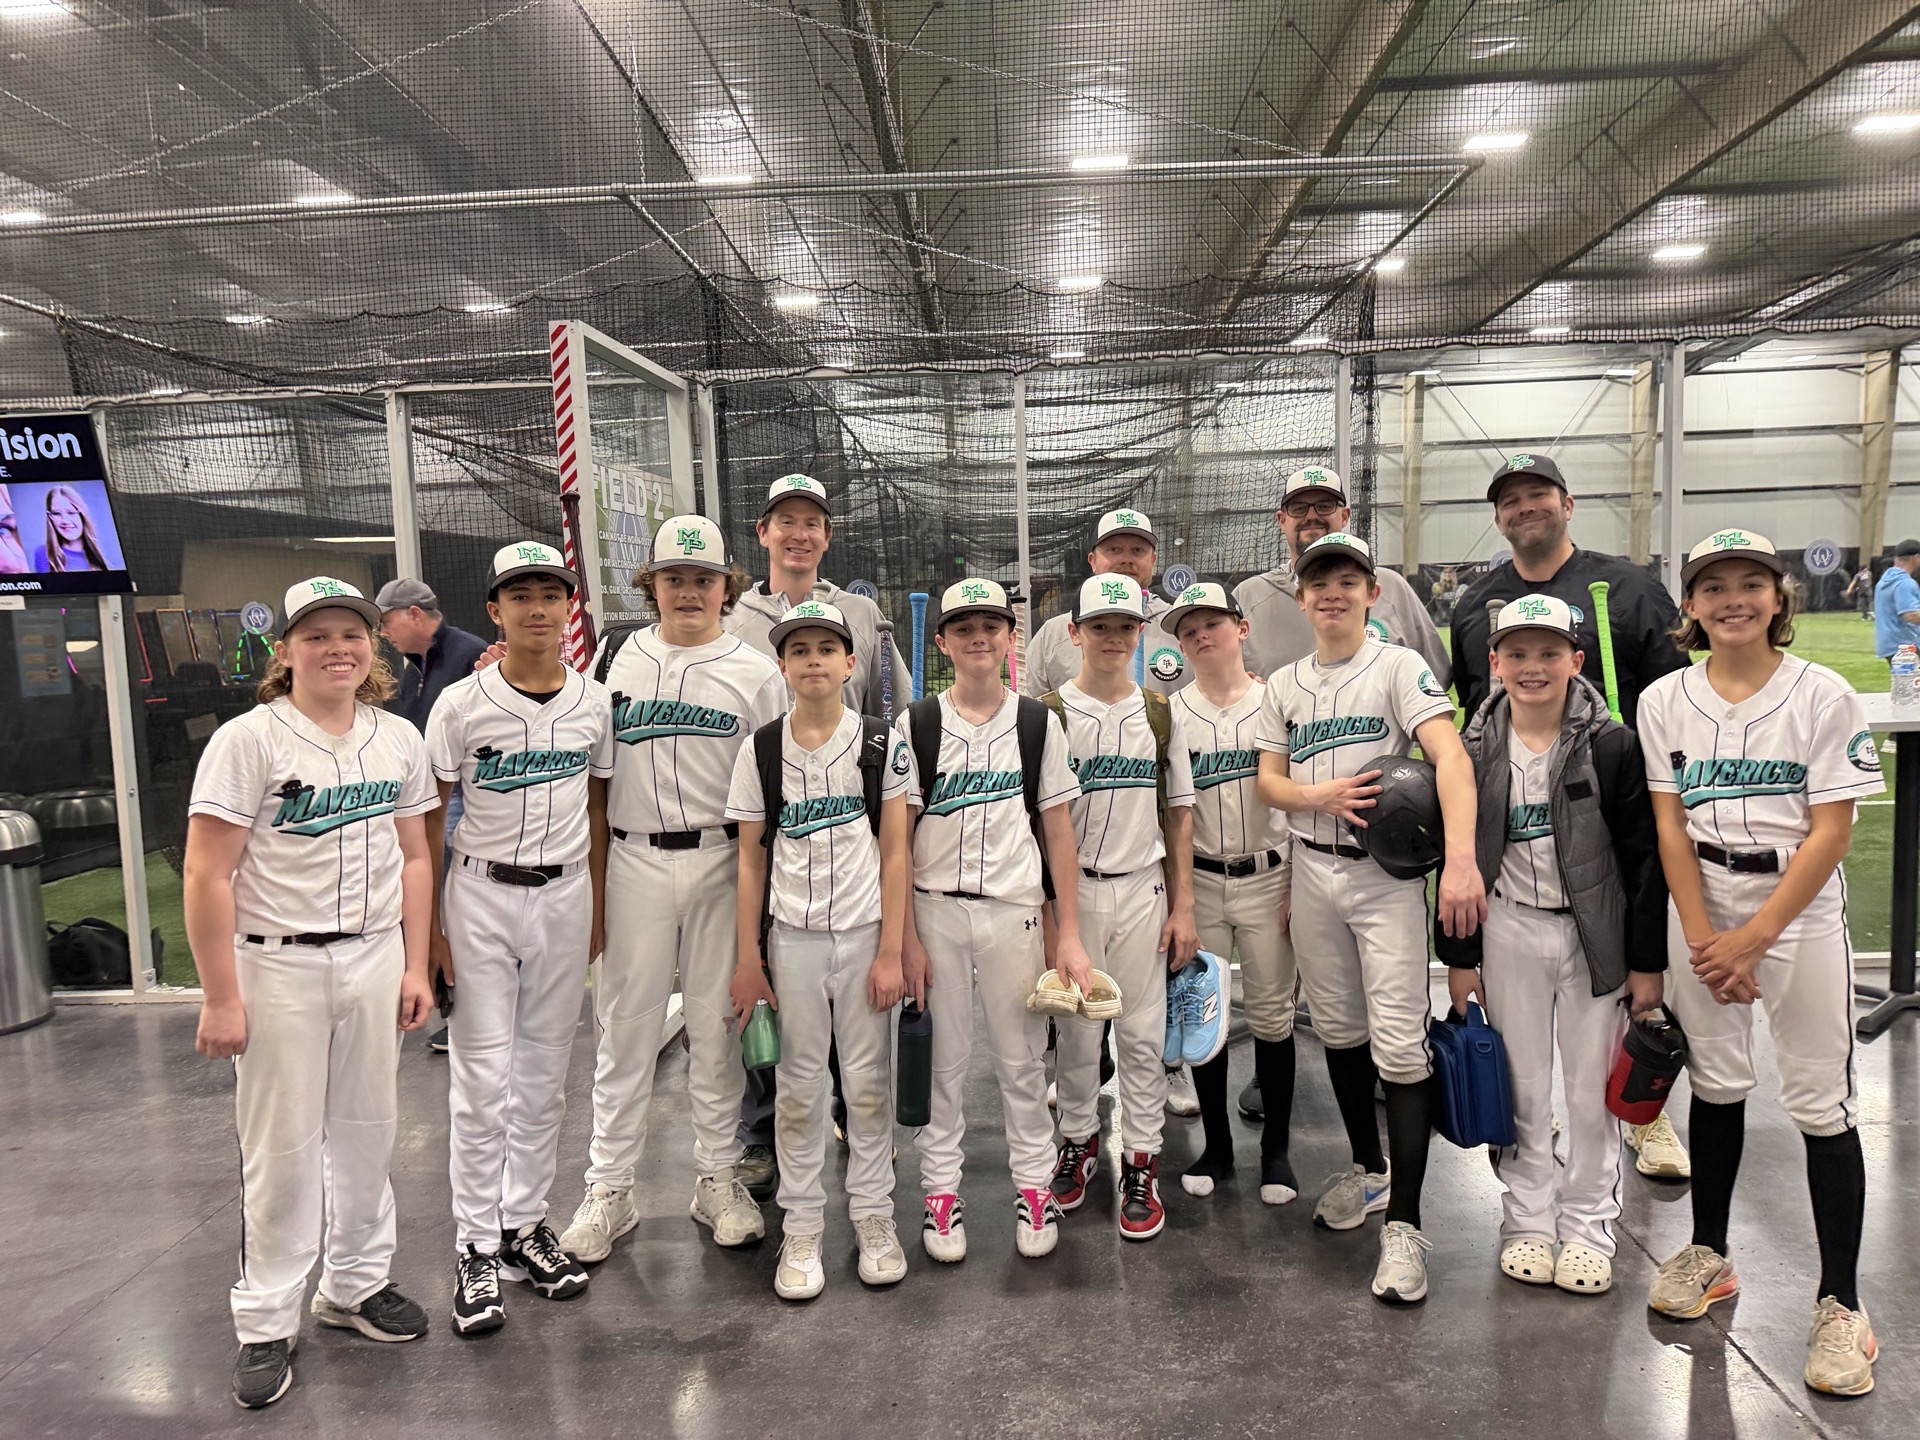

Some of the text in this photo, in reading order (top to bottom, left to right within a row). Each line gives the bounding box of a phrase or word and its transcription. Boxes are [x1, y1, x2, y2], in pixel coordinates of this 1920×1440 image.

[652, 482, 664, 521] 2
[613, 700, 737, 731] MAVERICKS
[1289, 716, 1384, 753] MAVERICKS
